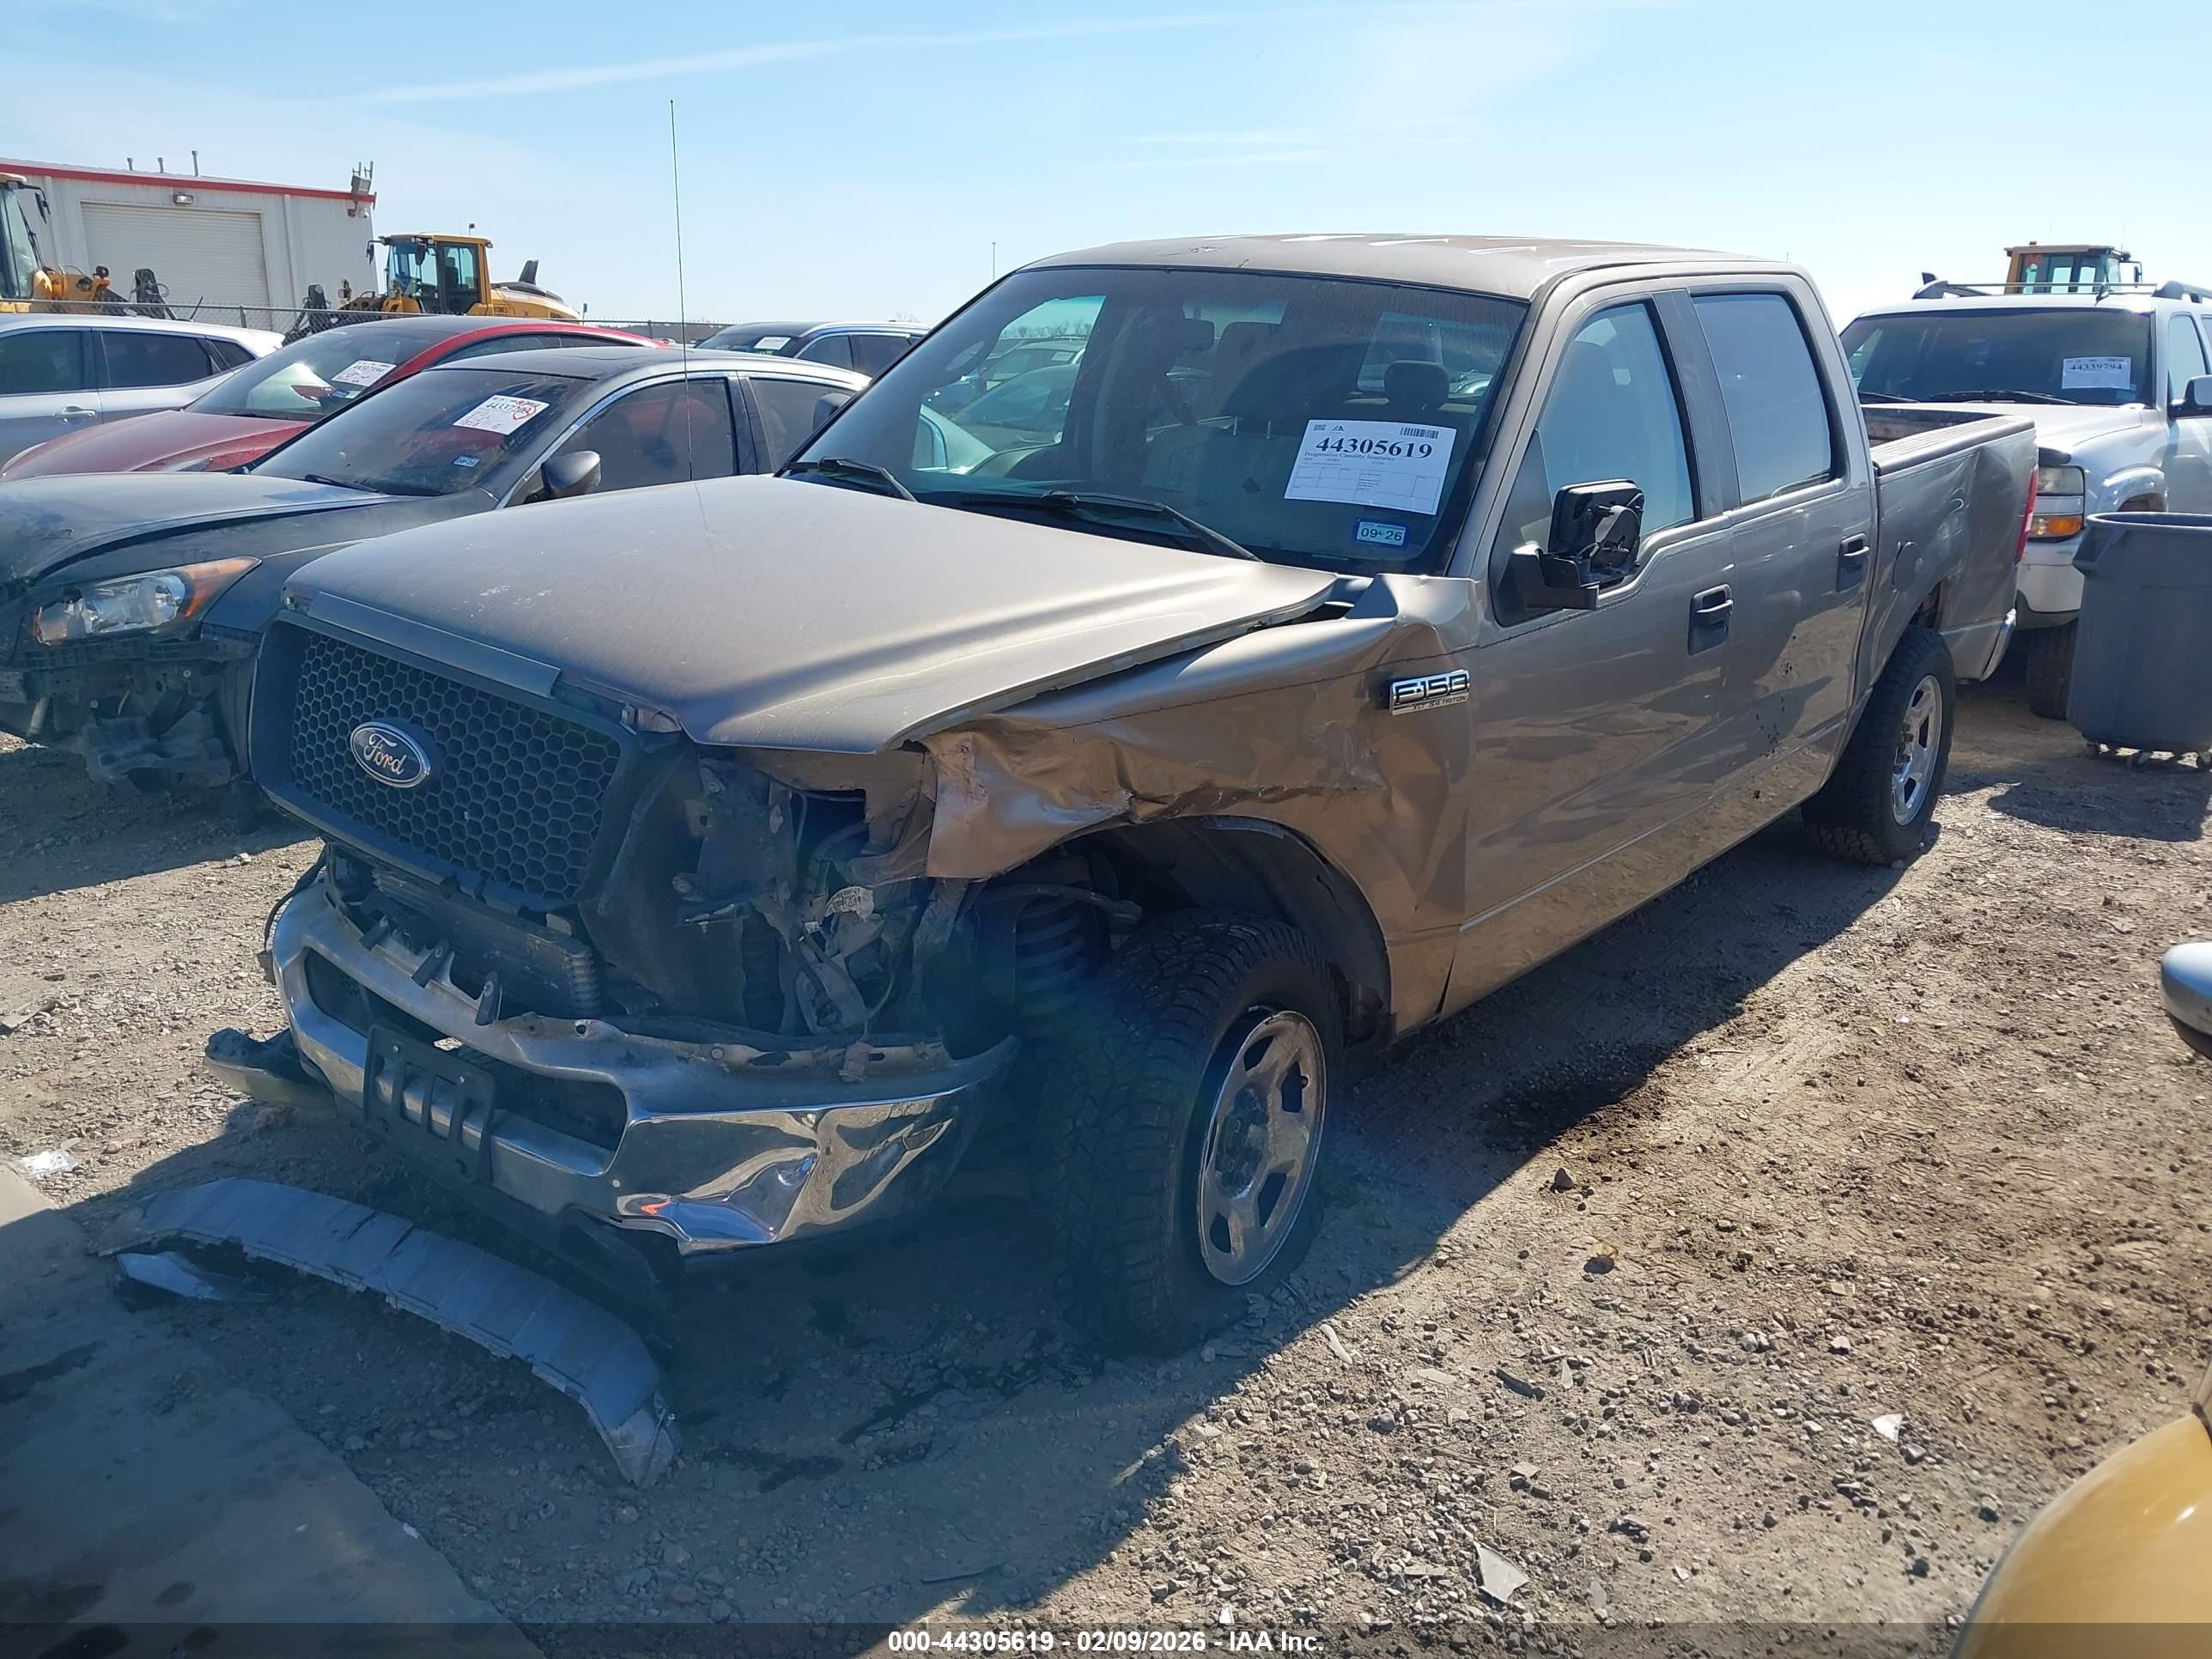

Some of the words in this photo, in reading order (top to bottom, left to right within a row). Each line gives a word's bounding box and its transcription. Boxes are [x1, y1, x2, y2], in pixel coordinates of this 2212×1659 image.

[1315, 436, 1433, 459] 44305619
[1360, 527, 1378, 538] 09
[1385, 529, 1403, 542] 26
[363, 732, 407, 775] Ford
